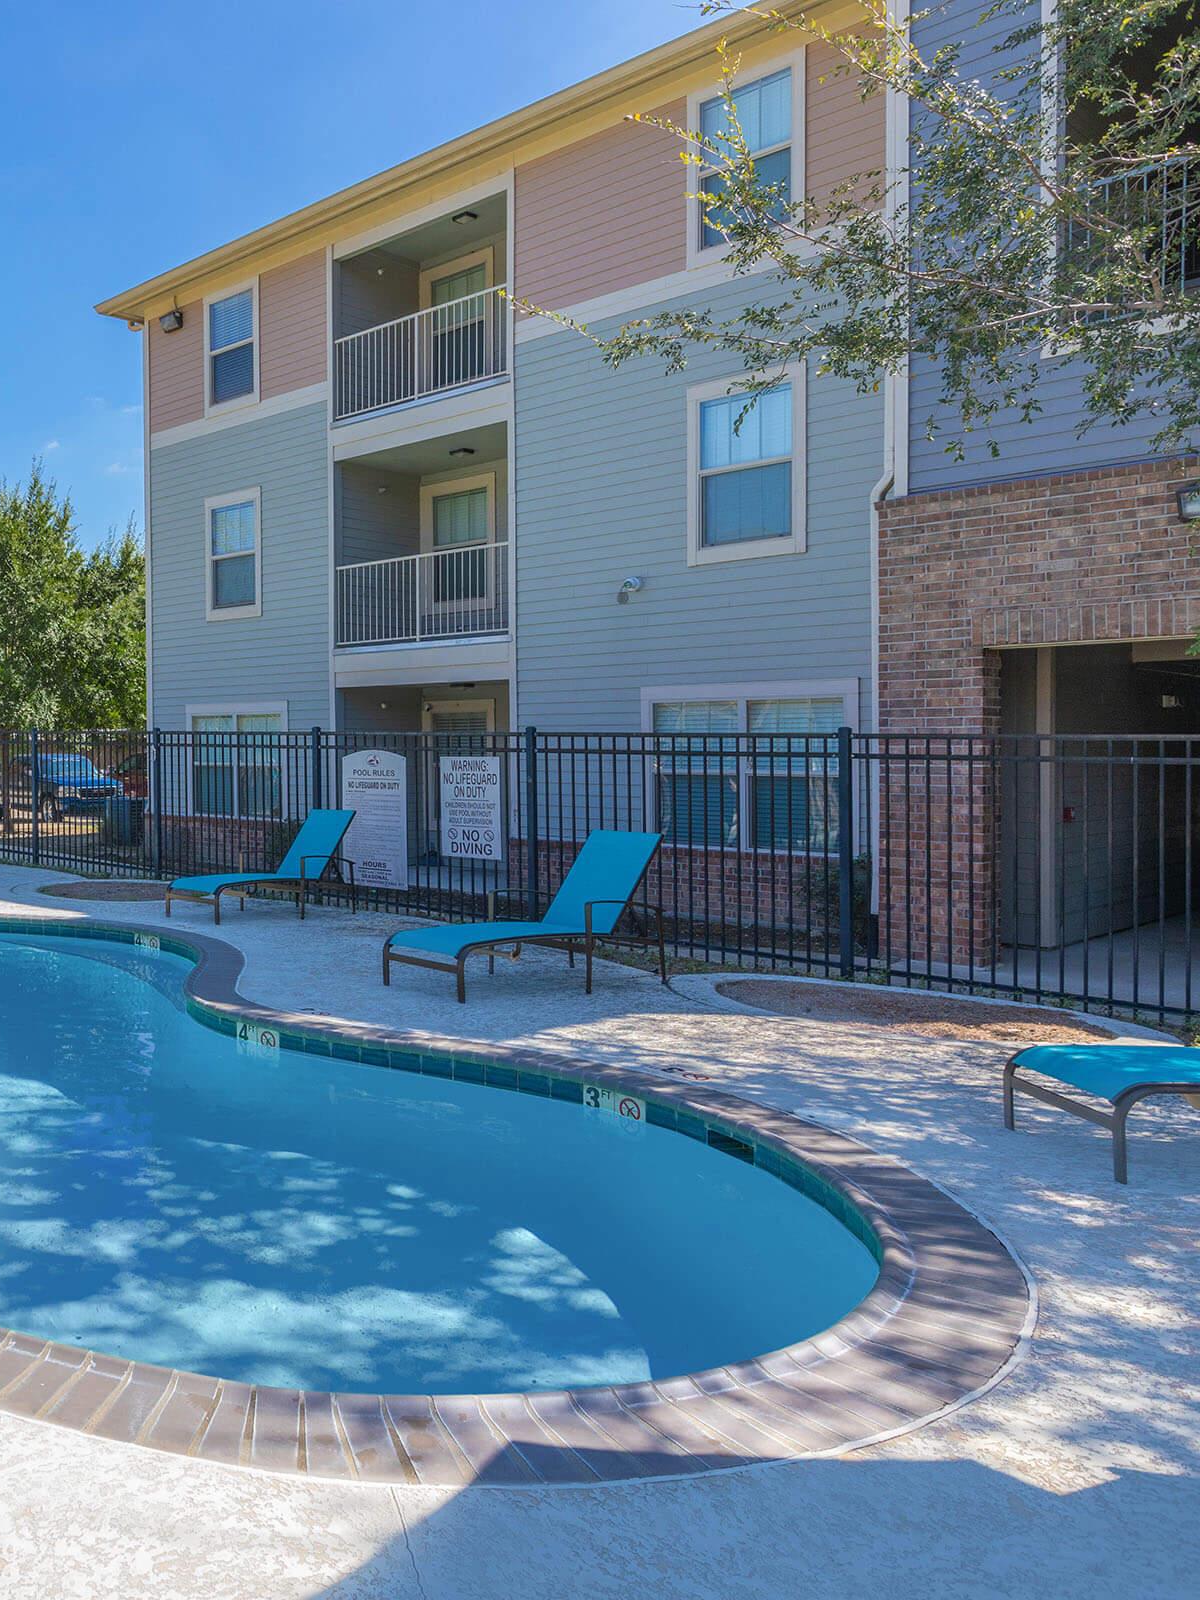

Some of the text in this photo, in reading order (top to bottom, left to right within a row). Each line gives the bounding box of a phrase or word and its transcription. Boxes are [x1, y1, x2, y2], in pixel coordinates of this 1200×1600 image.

[451, 760, 489, 772] WARNING:
[372, 769, 395, 777] RULES
[443, 773, 497, 785] NO LIFEGUARD
[454, 786, 486, 798] ON DUTY
[462, 829, 480, 842] NO
[451, 841, 493, 856] DIVING
[362, 860, 387, 868] HOURS
[238, 1023, 248, 1041] 4
[586, 1086, 610, 1108] 3 FT
